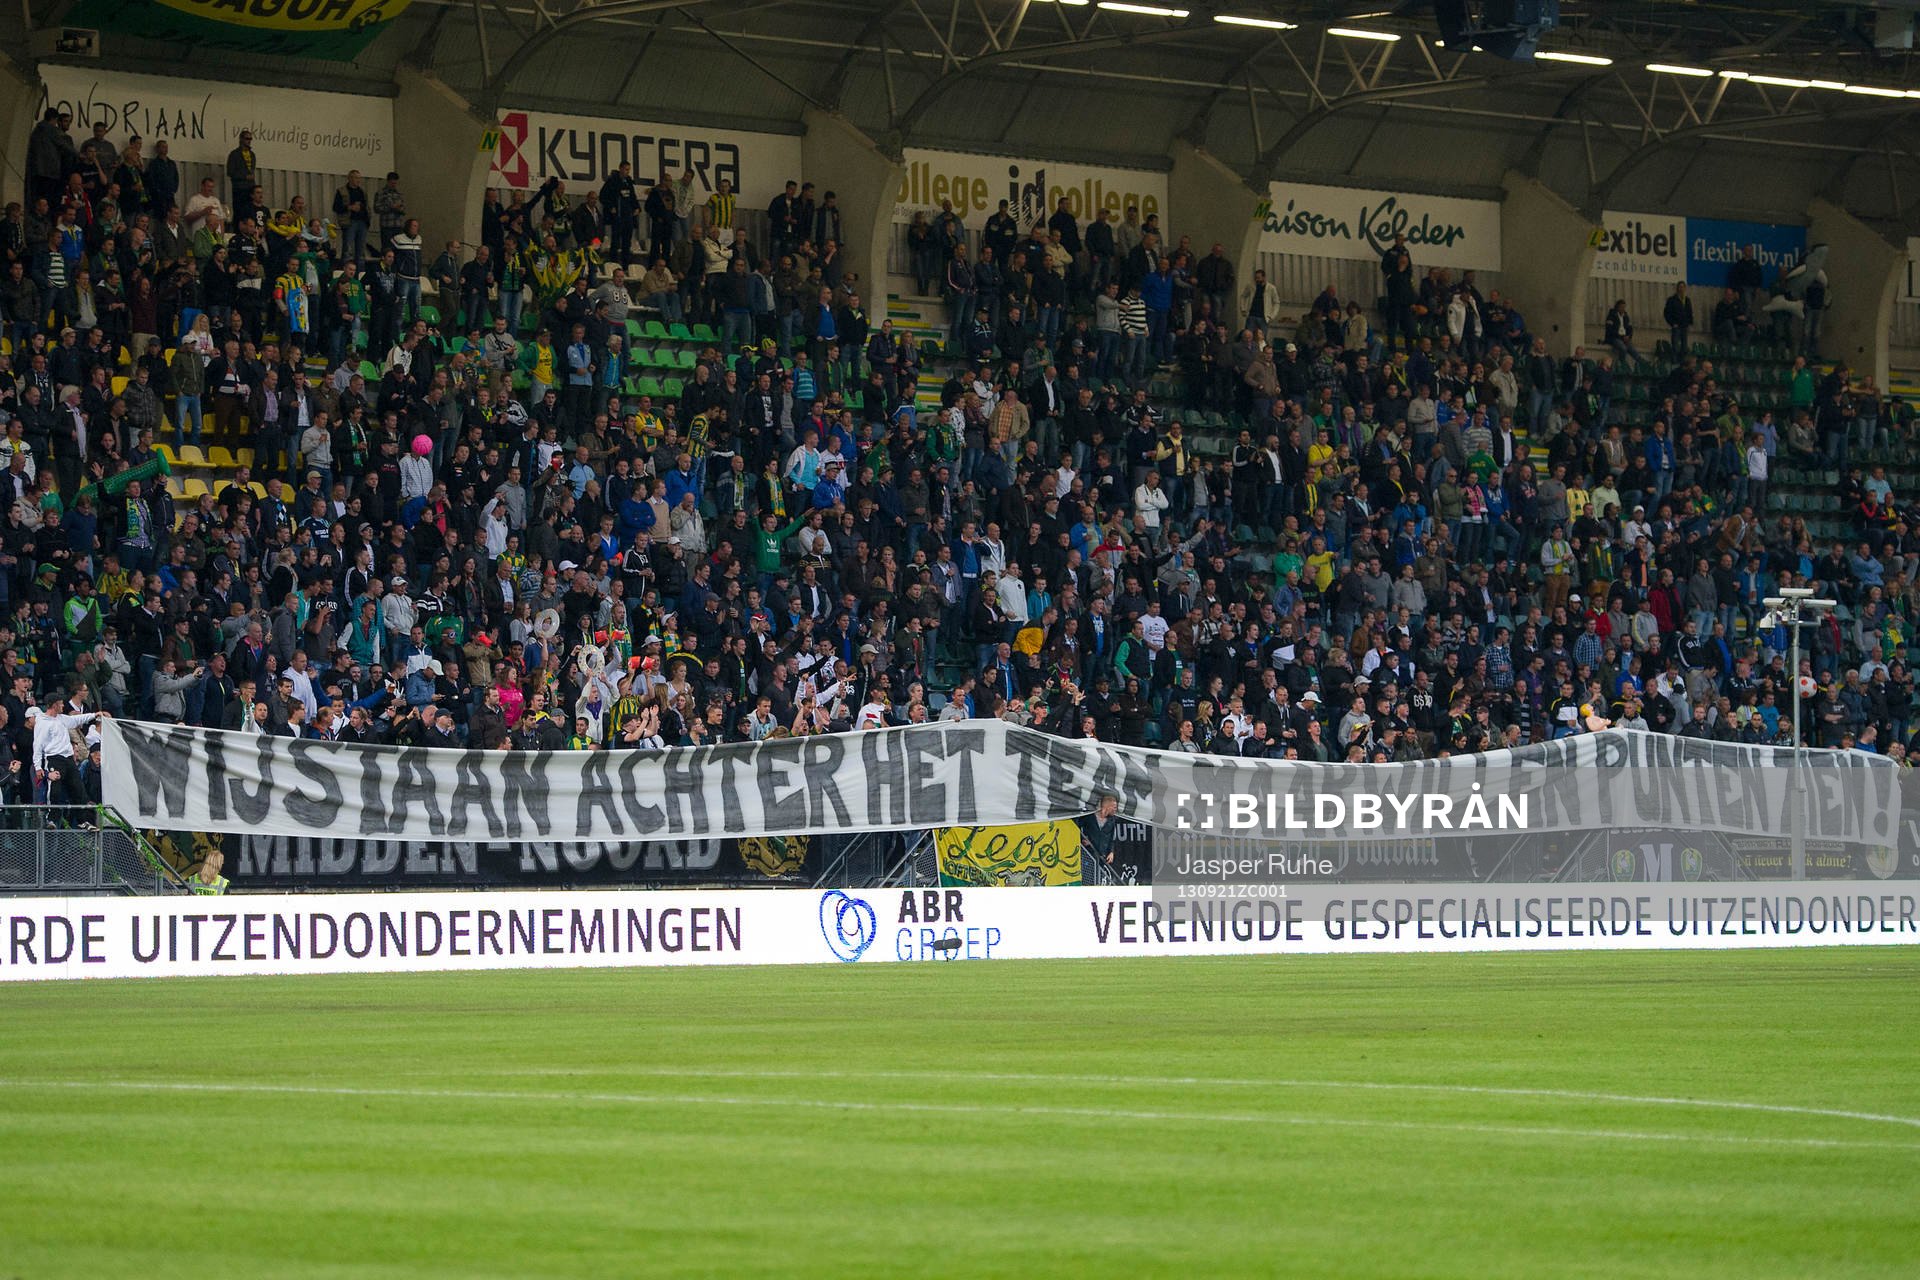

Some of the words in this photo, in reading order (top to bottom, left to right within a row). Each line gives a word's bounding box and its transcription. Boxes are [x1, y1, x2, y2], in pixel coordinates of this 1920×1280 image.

[314, 129, 382, 157] onderwijs
[482, 131, 499, 150] N
[539, 127, 741, 193] KYOCERA
[1049, 178, 1159, 224] college
[1358, 196, 1465, 257] Kelder
[1692, 238, 1800, 269] flexiblbv.nl
[117, 720, 275, 825] WIJ
[283, 739, 552, 838] STAAN
[576, 736, 851, 837] ACHTER
[862, 729, 985, 826] HET
[1596, 732, 1768, 832] PUNTEN
[898, 890, 964, 923] ABR
[1091, 900, 1303, 944] VERENIGDE
[1325, 897, 1652, 940] GESPECIALISEERDE
[1669, 895, 1917, 936] UITZENDONDER
[0, 914, 106, 965] RDE
[132, 907, 742, 963] UITZENDONDERNEMINGEN
[896, 926, 1001, 961] GROEP
